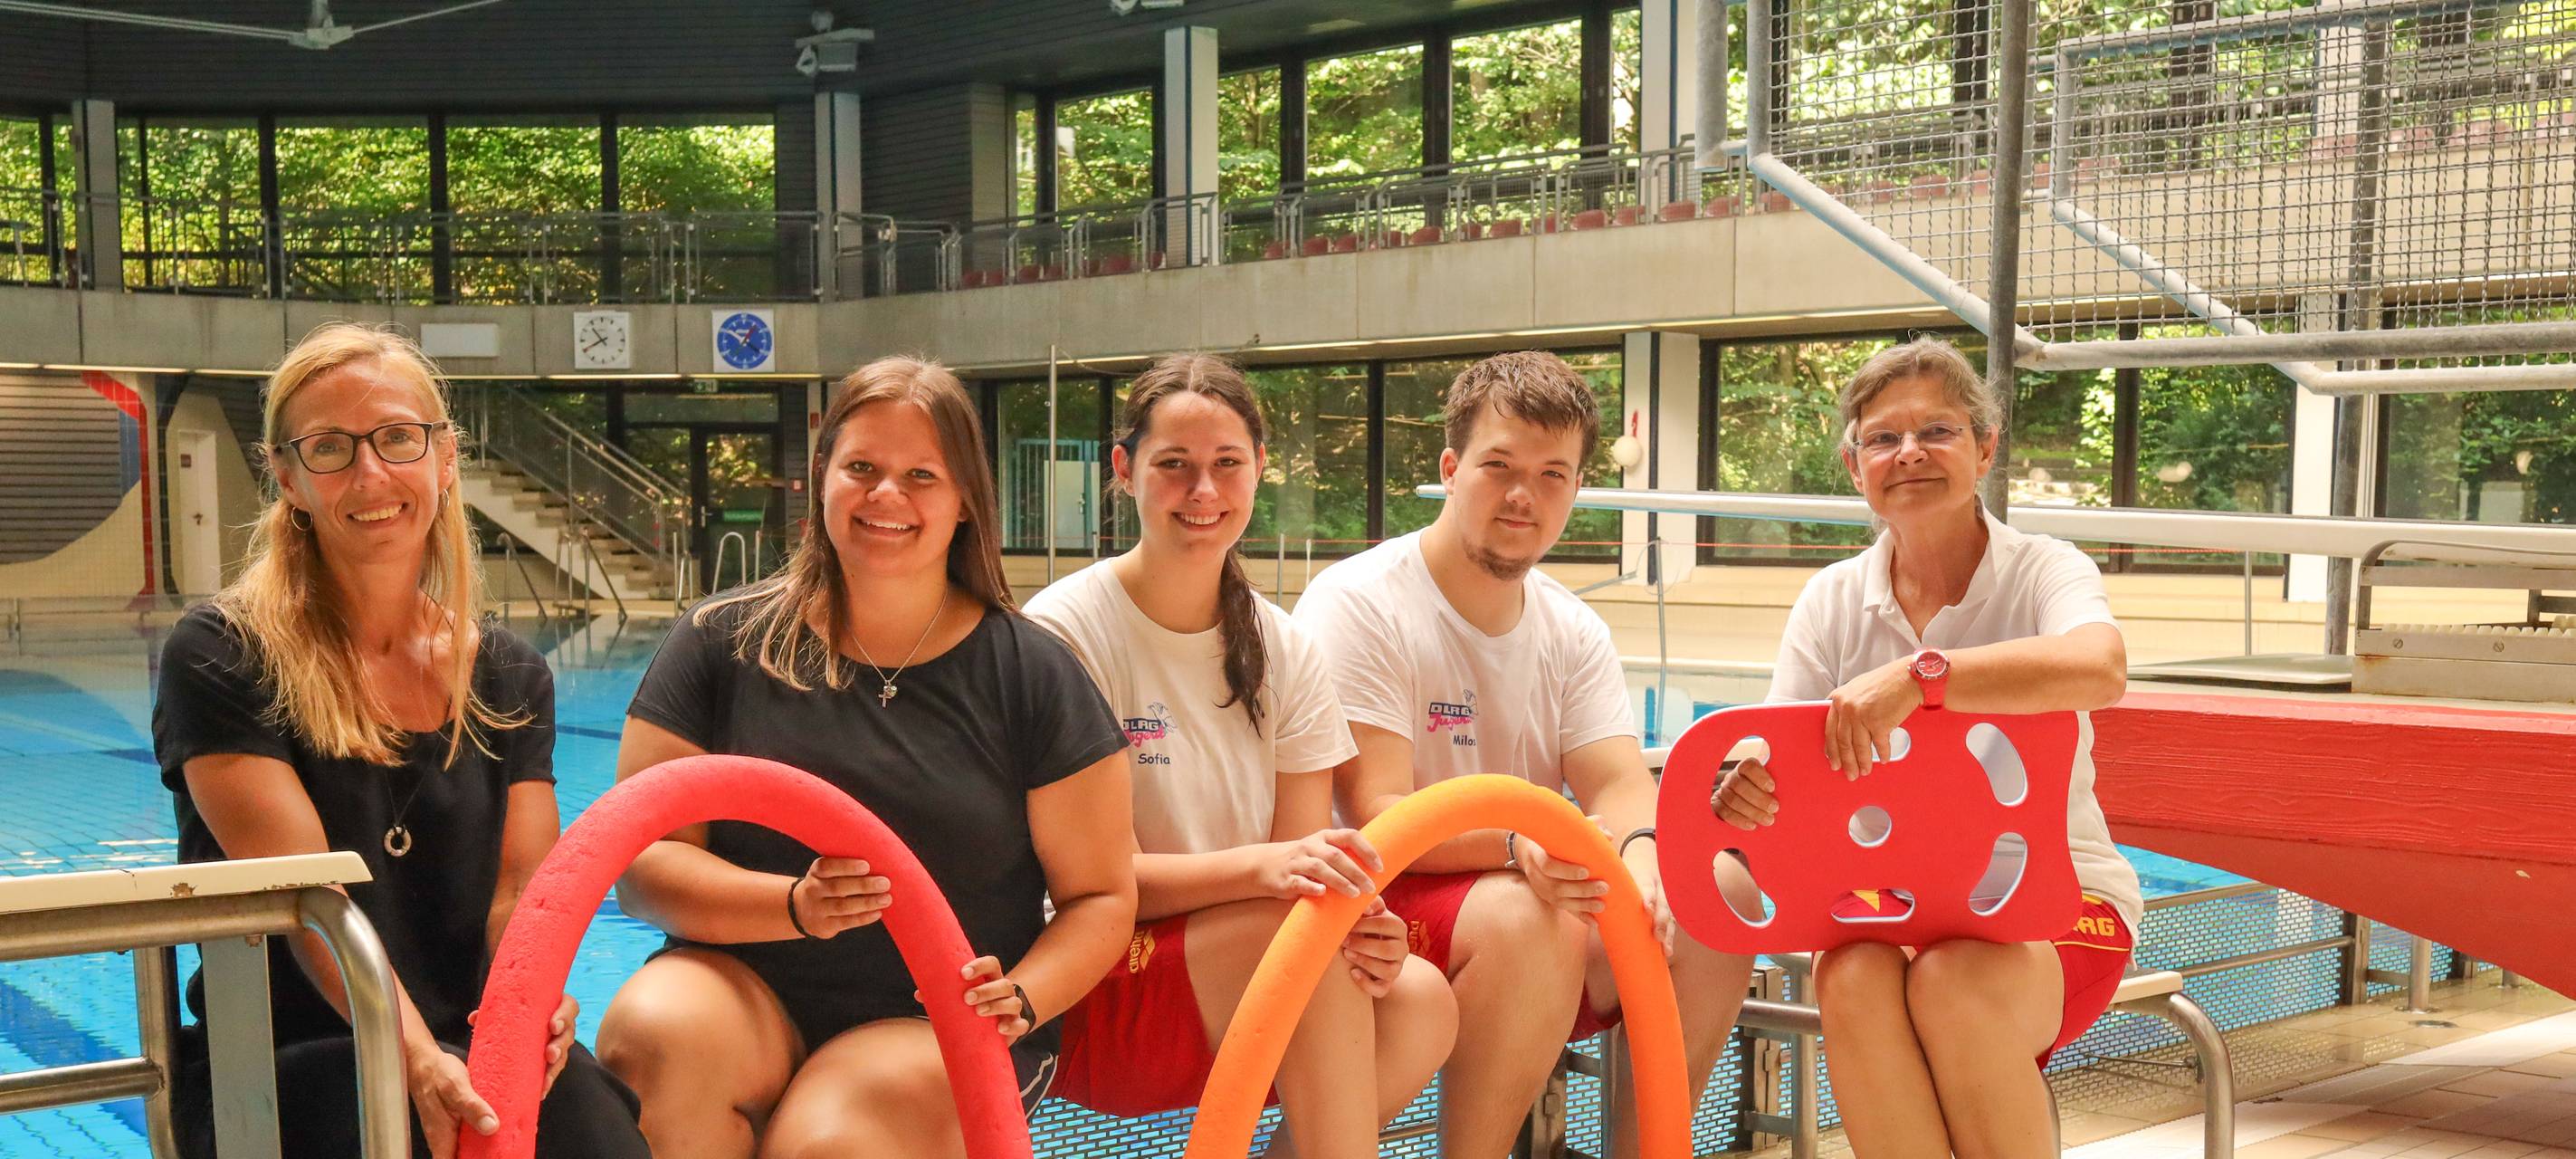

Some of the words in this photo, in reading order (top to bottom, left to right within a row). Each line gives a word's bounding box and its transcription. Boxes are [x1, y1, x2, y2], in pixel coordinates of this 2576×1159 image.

[1429, 703, 1471, 717] DLRG
[1426, 714, 1472, 733] Jugen
[1124, 725, 1166, 748] ugend
[1453, 734, 1476, 746] Milos
[1138, 753, 1170, 764] Sofia
[2073, 916, 2115, 937] RG
[1129, 930, 1145, 974] arena
